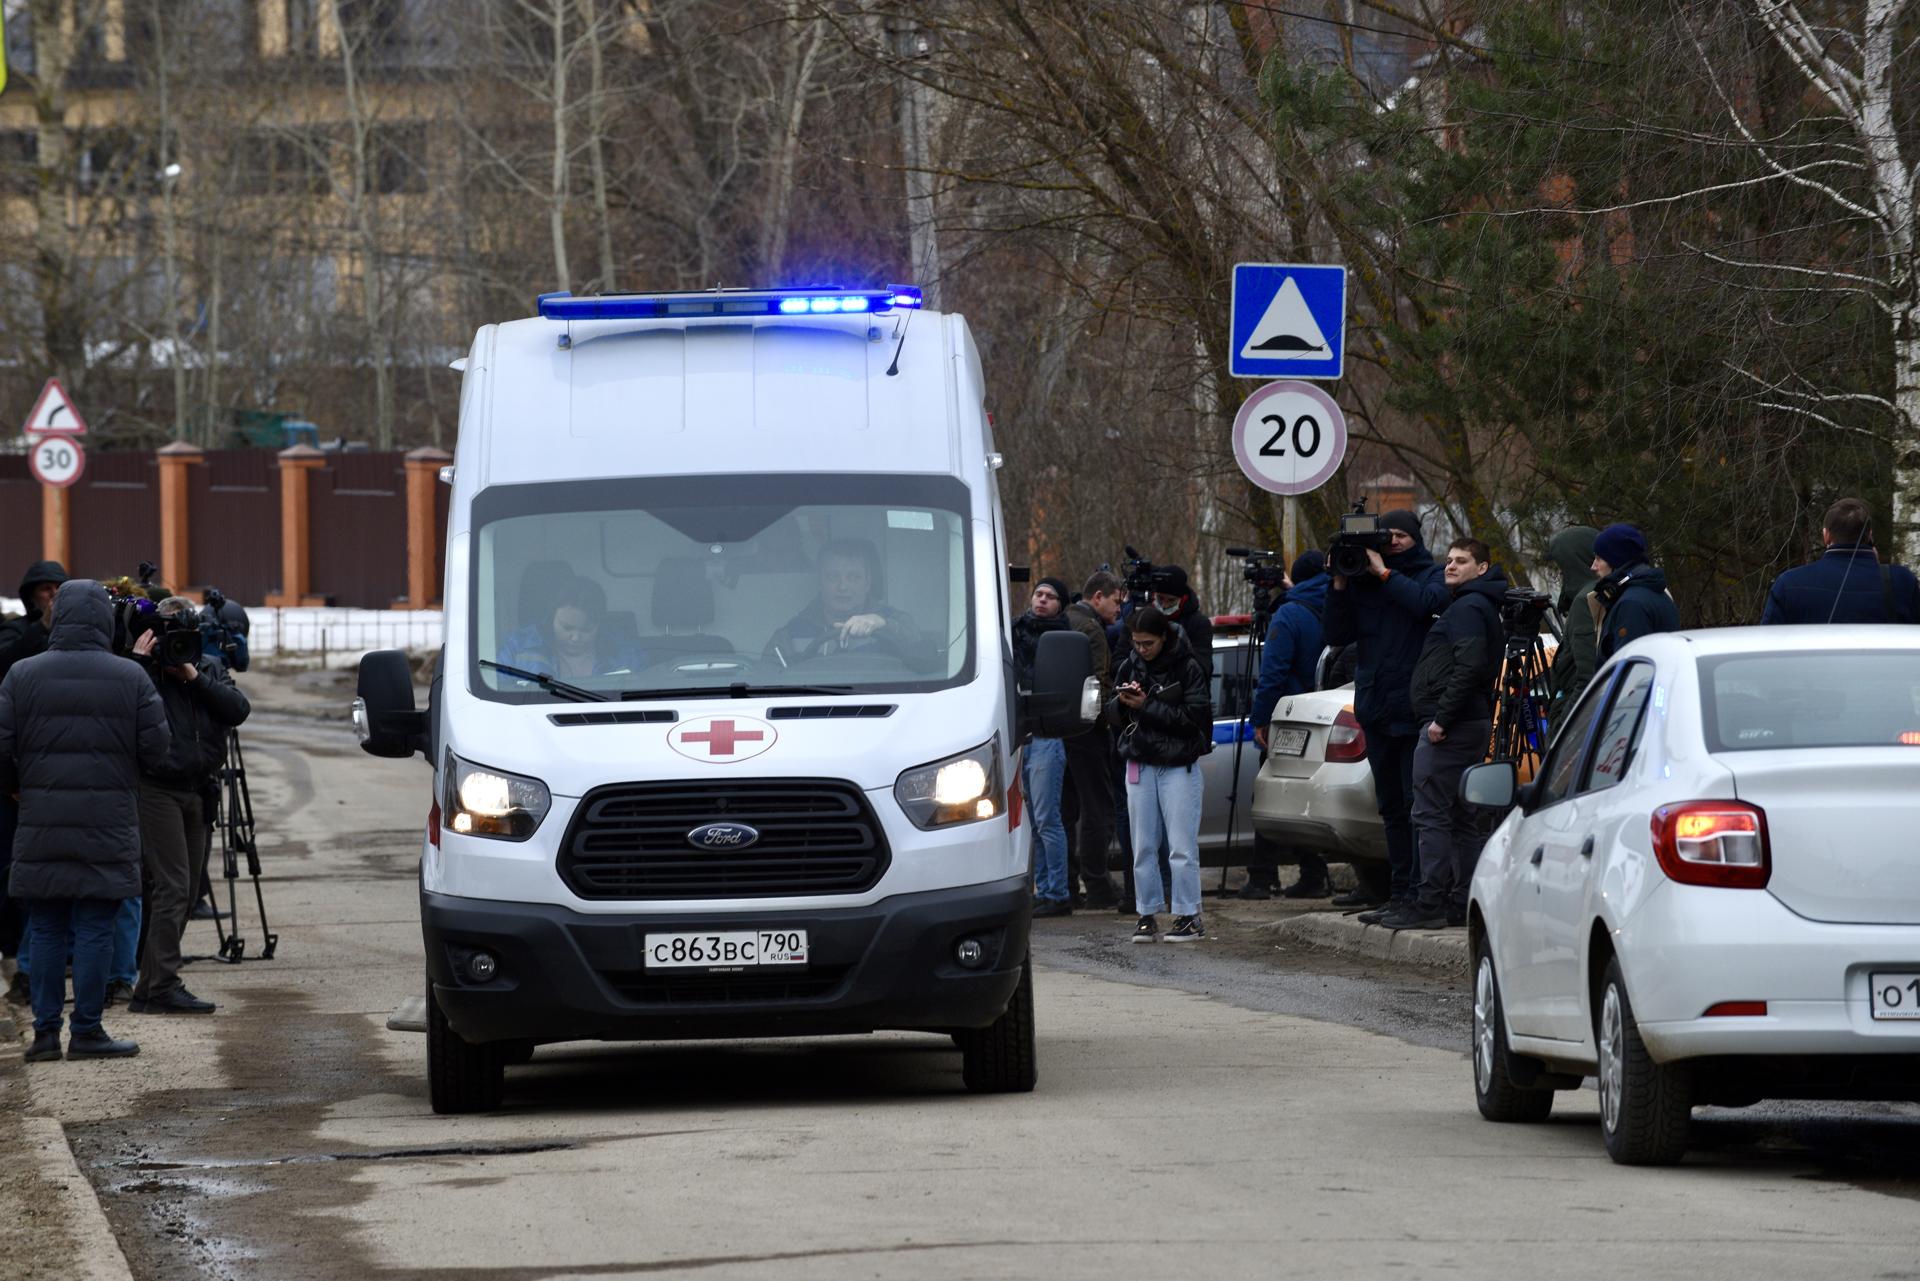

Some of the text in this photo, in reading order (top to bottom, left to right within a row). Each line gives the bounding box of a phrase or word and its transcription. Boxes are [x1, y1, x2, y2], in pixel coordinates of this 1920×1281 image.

[1259, 414, 1321, 458] 20
[42, 448, 72, 470] 30
[703, 827, 742, 845] Ford
[760, 933, 800, 953] 790
[770, 953, 790, 961] RUS
